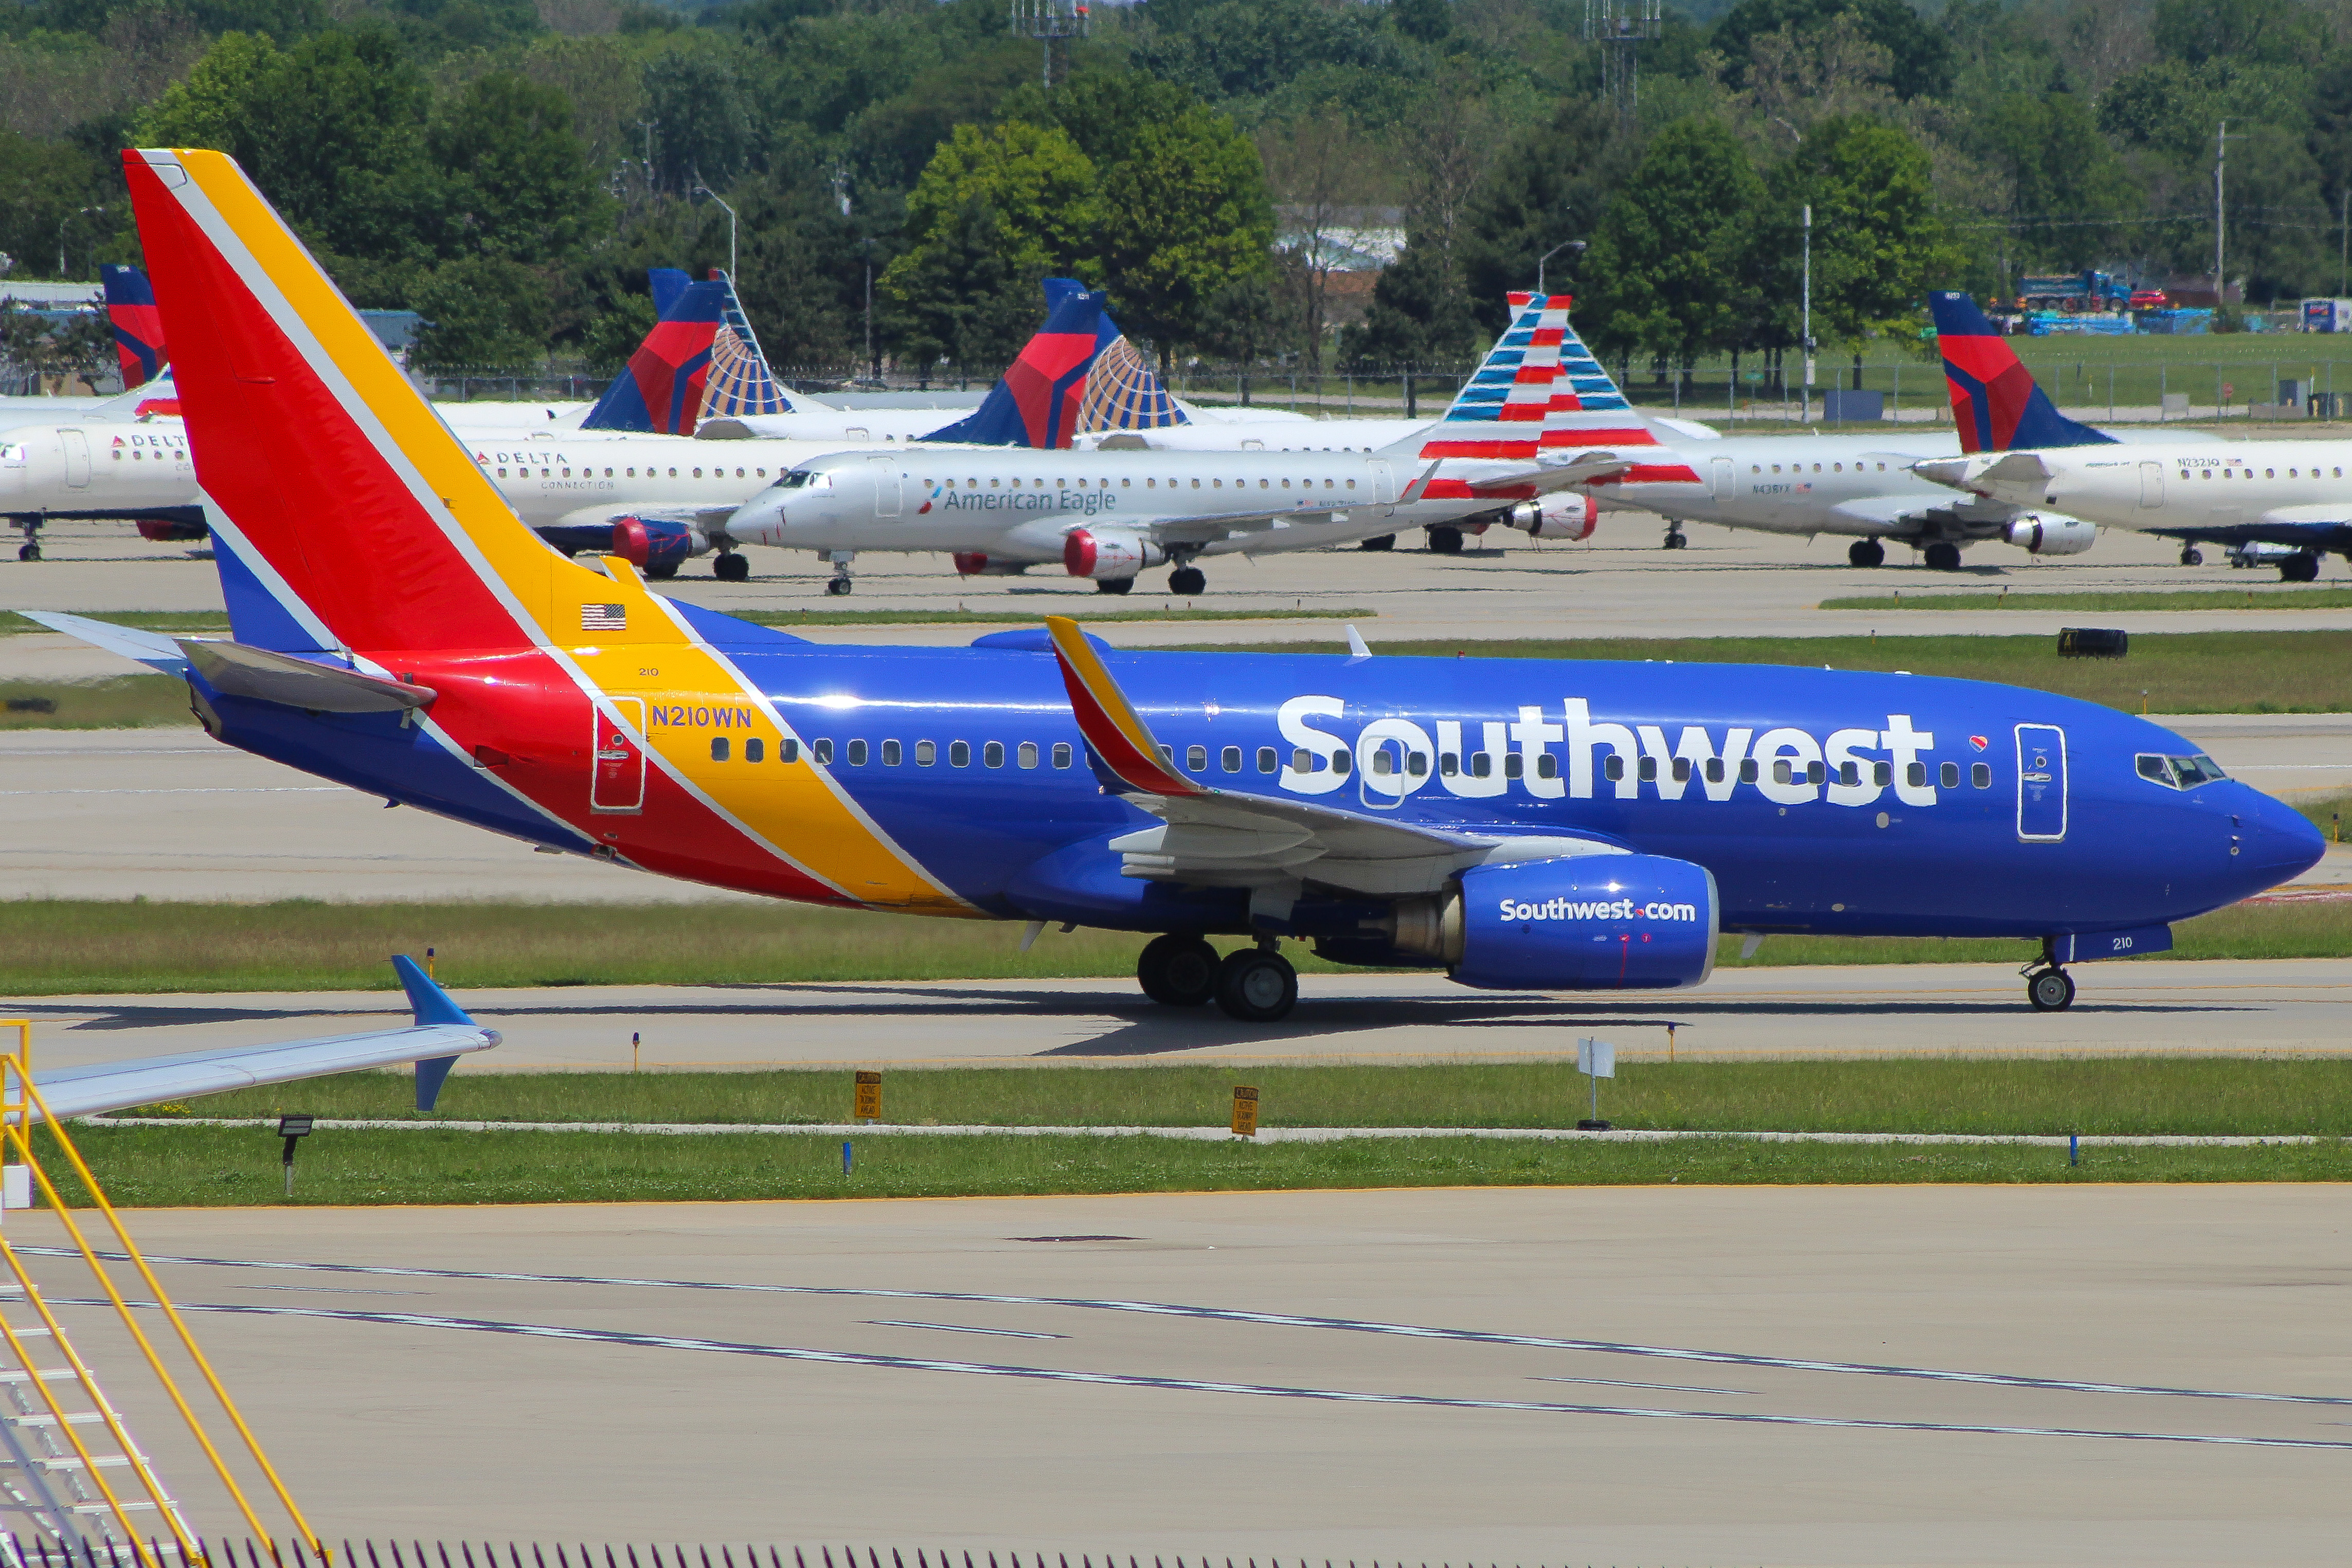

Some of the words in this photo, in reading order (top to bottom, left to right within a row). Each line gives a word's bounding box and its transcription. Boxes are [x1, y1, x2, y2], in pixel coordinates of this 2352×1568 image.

[496, 452, 568, 464] DELTA
[541, 480, 614, 490] CONNECTION
[944, 489, 1052, 510] American
[1060, 489, 1117, 516] Eagle
[639, 668, 659, 676] 210
[652, 706, 751, 728] N210WN
[1278, 695, 1937, 807] Southwest
[2113, 936, 2132, 951] 210
